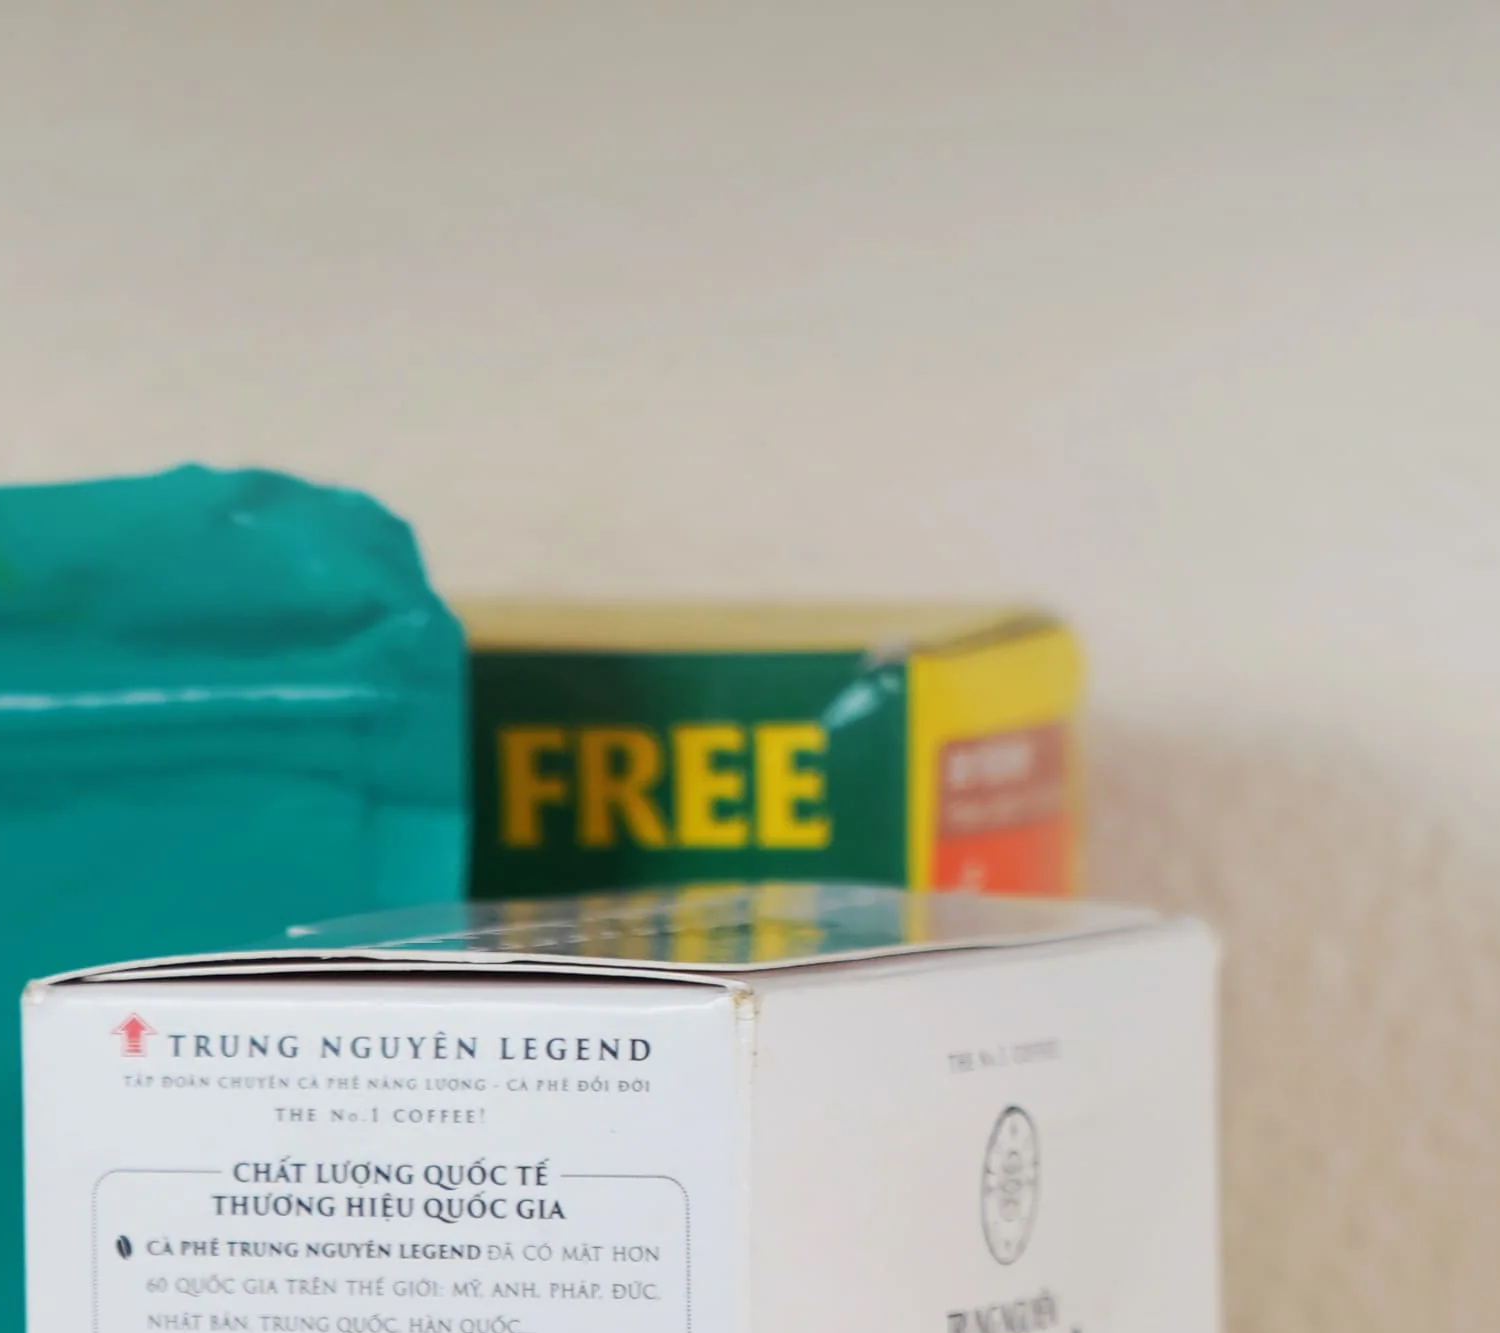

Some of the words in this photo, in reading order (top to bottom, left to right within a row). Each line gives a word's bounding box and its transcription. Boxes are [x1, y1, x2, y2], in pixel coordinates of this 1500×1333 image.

[499, 722, 831, 849] FREE
[167, 1034, 300, 1059] TRUNG
[320, 1031, 478, 1060] NGUYÊN
[499, 1037, 652, 1061] LEGEND
[274, 1107, 318, 1122] THE
[393, 1107, 486, 1124] COFFEE!
[232, 1156, 307, 1185] CHẤT
[316, 1161, 415, 1189] LƯỢNG
[423, 1158, 510, 1191] QUỐC
[516, 1159, 549, 1188] TẾ
[212, 1194, 340, 1217] THƯƠNG
[346, 1194, 414, 1221] HIỆU
[422, 1192, 513, 1223] QUỐC
[519, 1199, 567, 1221] GIA
[145, 1238, 174, 1257] CÀ
[180, 1237, 221, 1257] PHÊ
[226, 1241, 299, 1258] TRUNG
[305, 1239, 392, 1259] NGUYÊN
[399, 1243, 481, 1260] LEGEND
[523, 1241, 553, 1262] CÓ
[145, 1278, 169, 1294] 60
[174, 1272, 236, 1297] QUỐC
[242, 1277, 279, 1295] GIA
[285, 1275, 337, 1296] TRÊN
[346, 1273, 385, 1296] THẾ
[259, 1315, 330, 1333] TRUNG
[409, 1314, 452, 1333] HÀN
